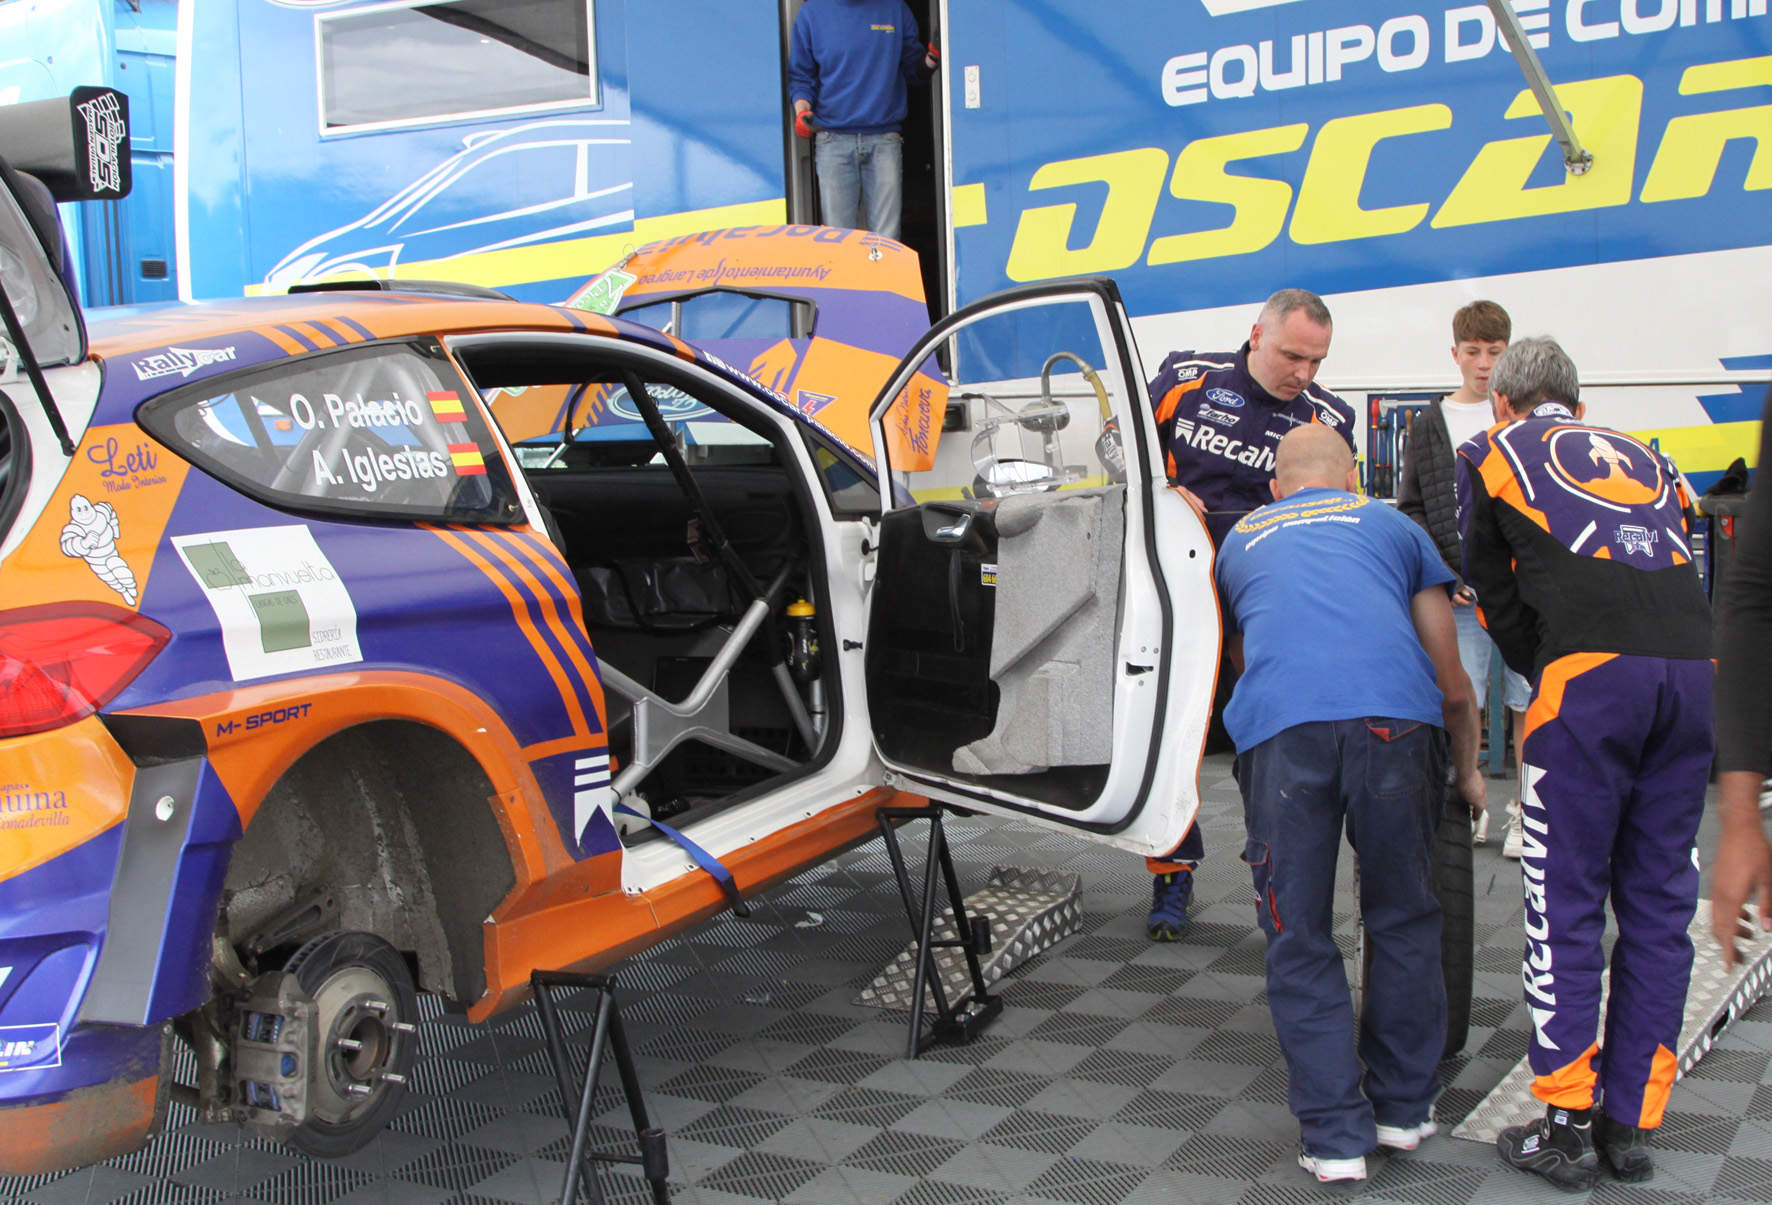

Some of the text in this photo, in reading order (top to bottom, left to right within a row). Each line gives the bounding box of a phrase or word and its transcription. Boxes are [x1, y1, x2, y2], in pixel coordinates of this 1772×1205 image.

[1161, 15, 1430, 107] EQUIPO
[1445, 0, 1550, 63] DE
[94, 110, 113, 187] SDS
[638, 265, 693, 286] Langreo
[729, 264, 832, 282] Ayuntamiento
[290, 392, 424, 430] O. Palacio
[87, 437, 157, 477] Leti
[1191, 424, 1277, 472] Recalv
[312, 444, 448, 492] A. Iglesias
[246, 702, 313, 731] SPORT
[0, 790, 68, 814] uina
